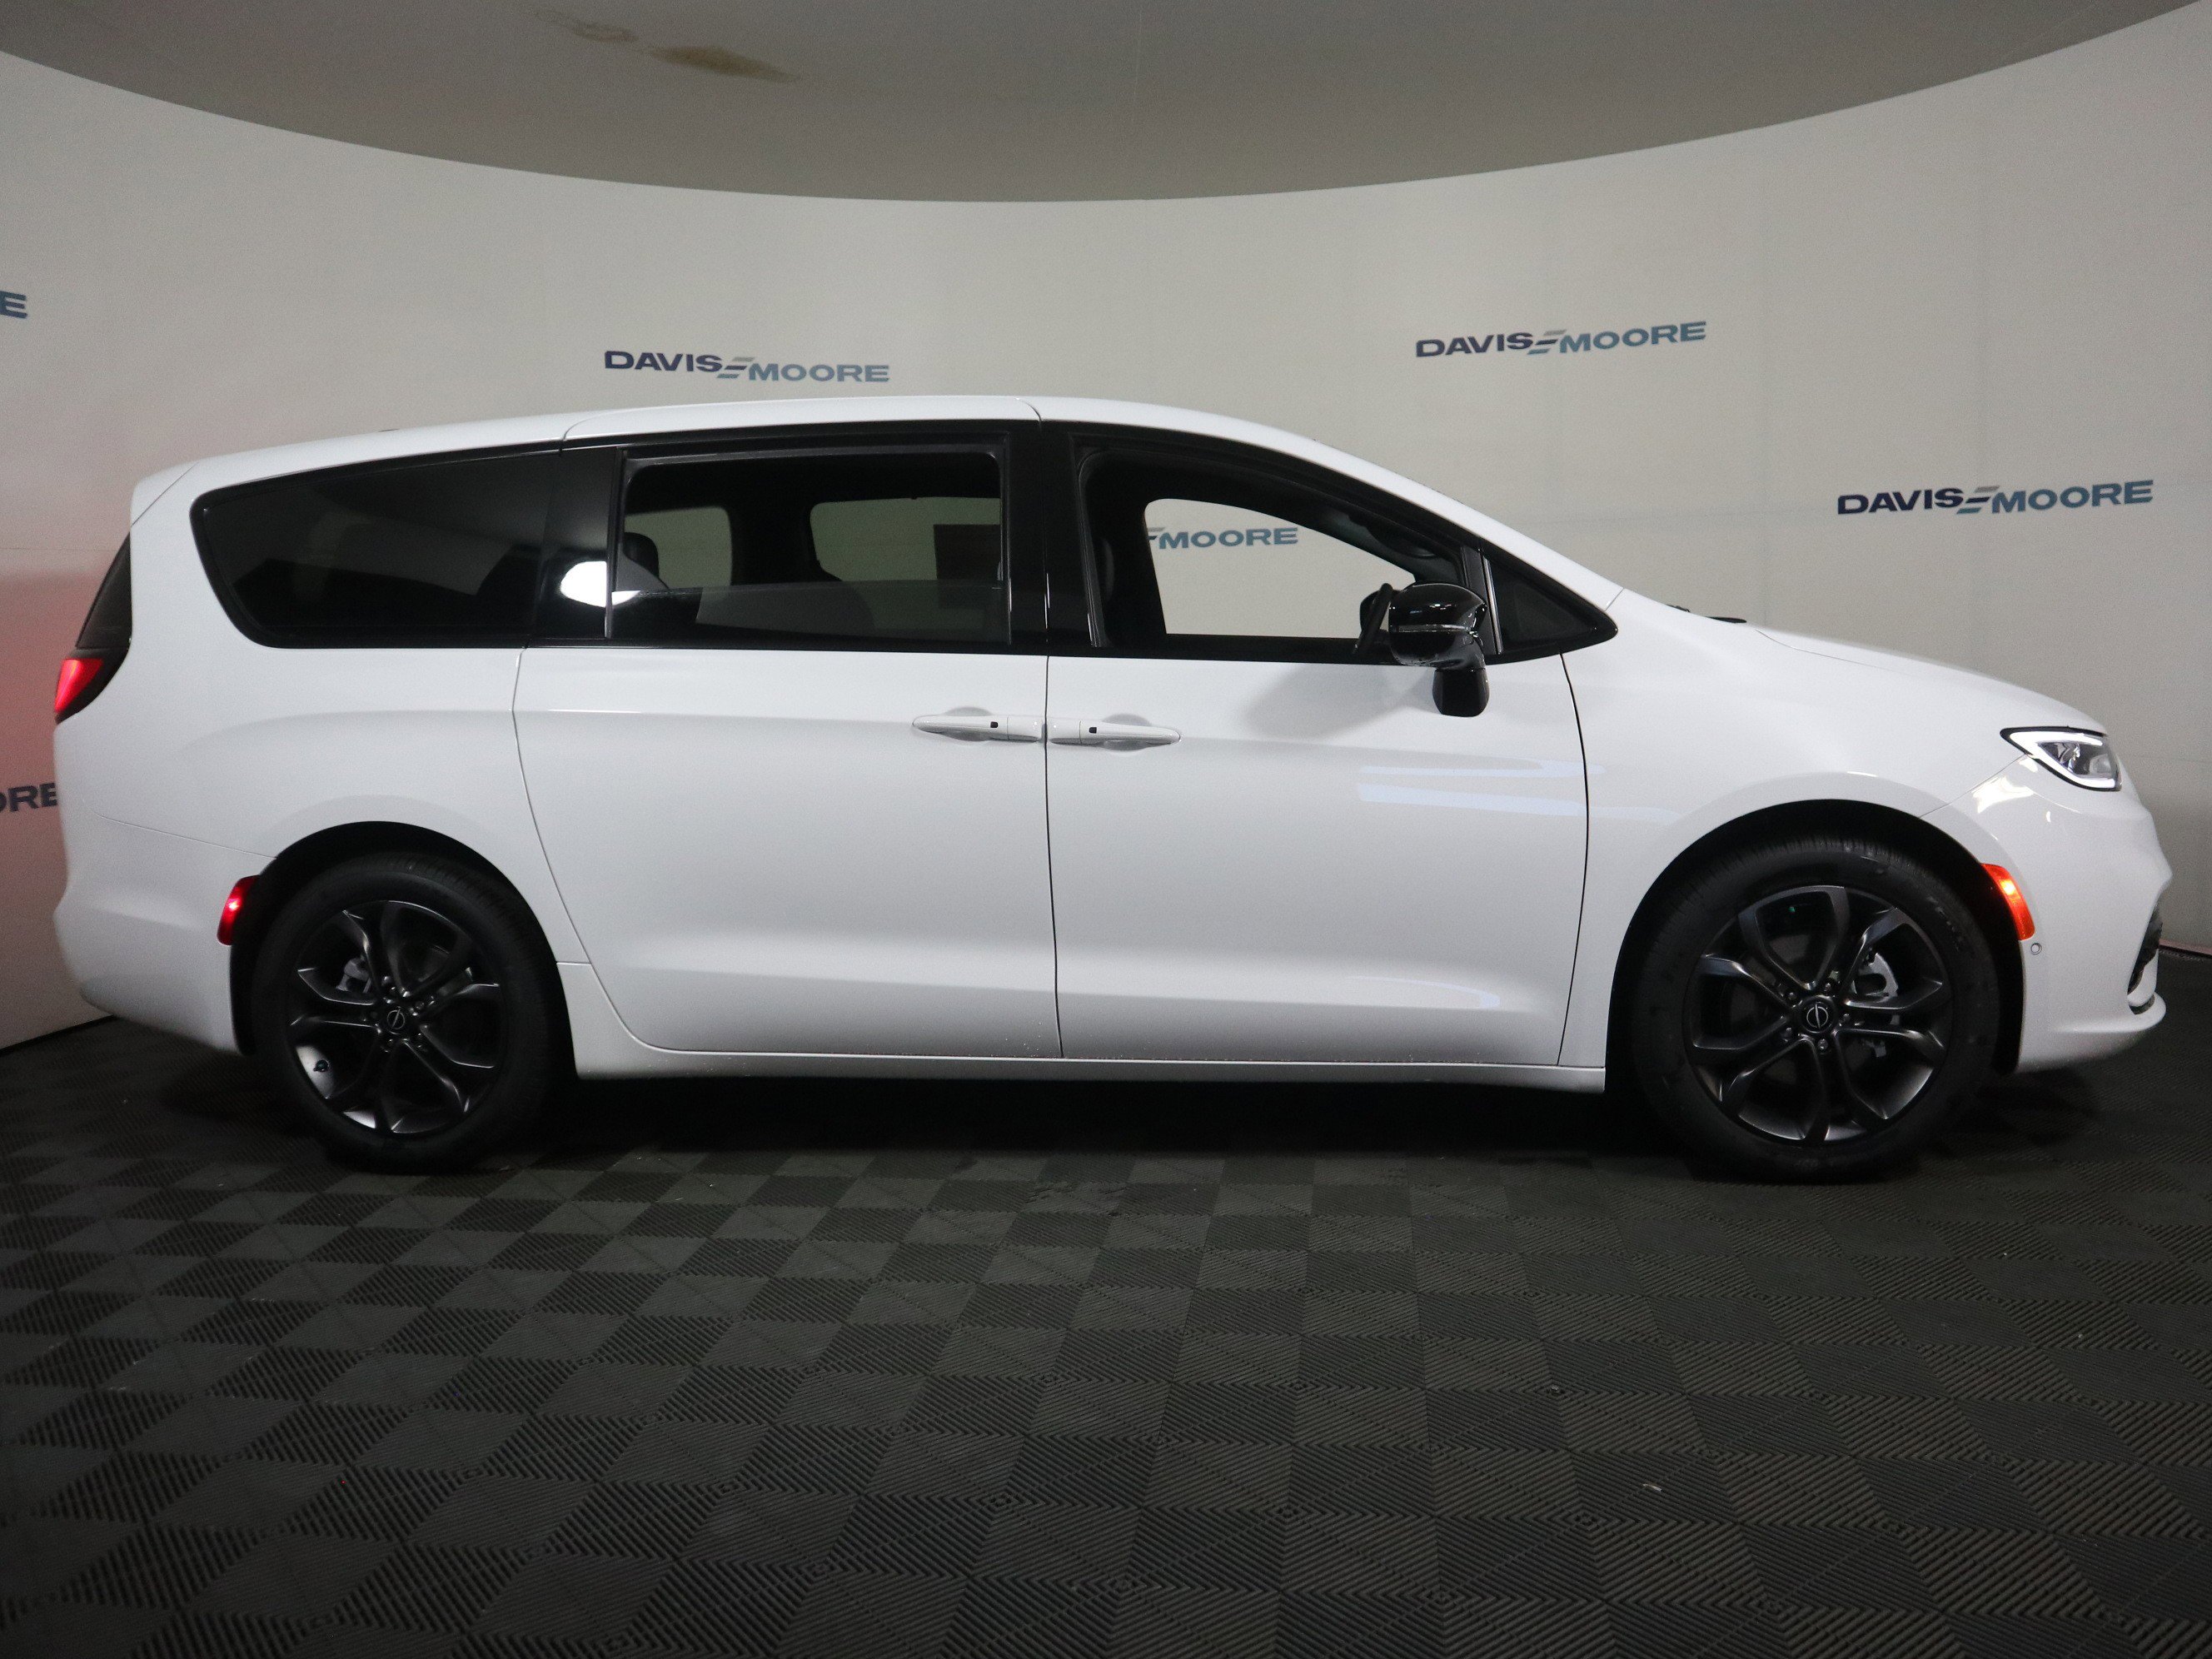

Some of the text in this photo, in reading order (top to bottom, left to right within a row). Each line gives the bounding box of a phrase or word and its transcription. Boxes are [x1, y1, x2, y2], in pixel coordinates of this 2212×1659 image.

[1416, 320, 1706, 357] DAVIS MOORE
[604, 350, 890, 382] DAVIS MOORE
[1837, 479, 2155, 515] DAVIS MOORE
[1158, 526, 1299, 550] MOORE
[0, 782, 57, 813] RE
